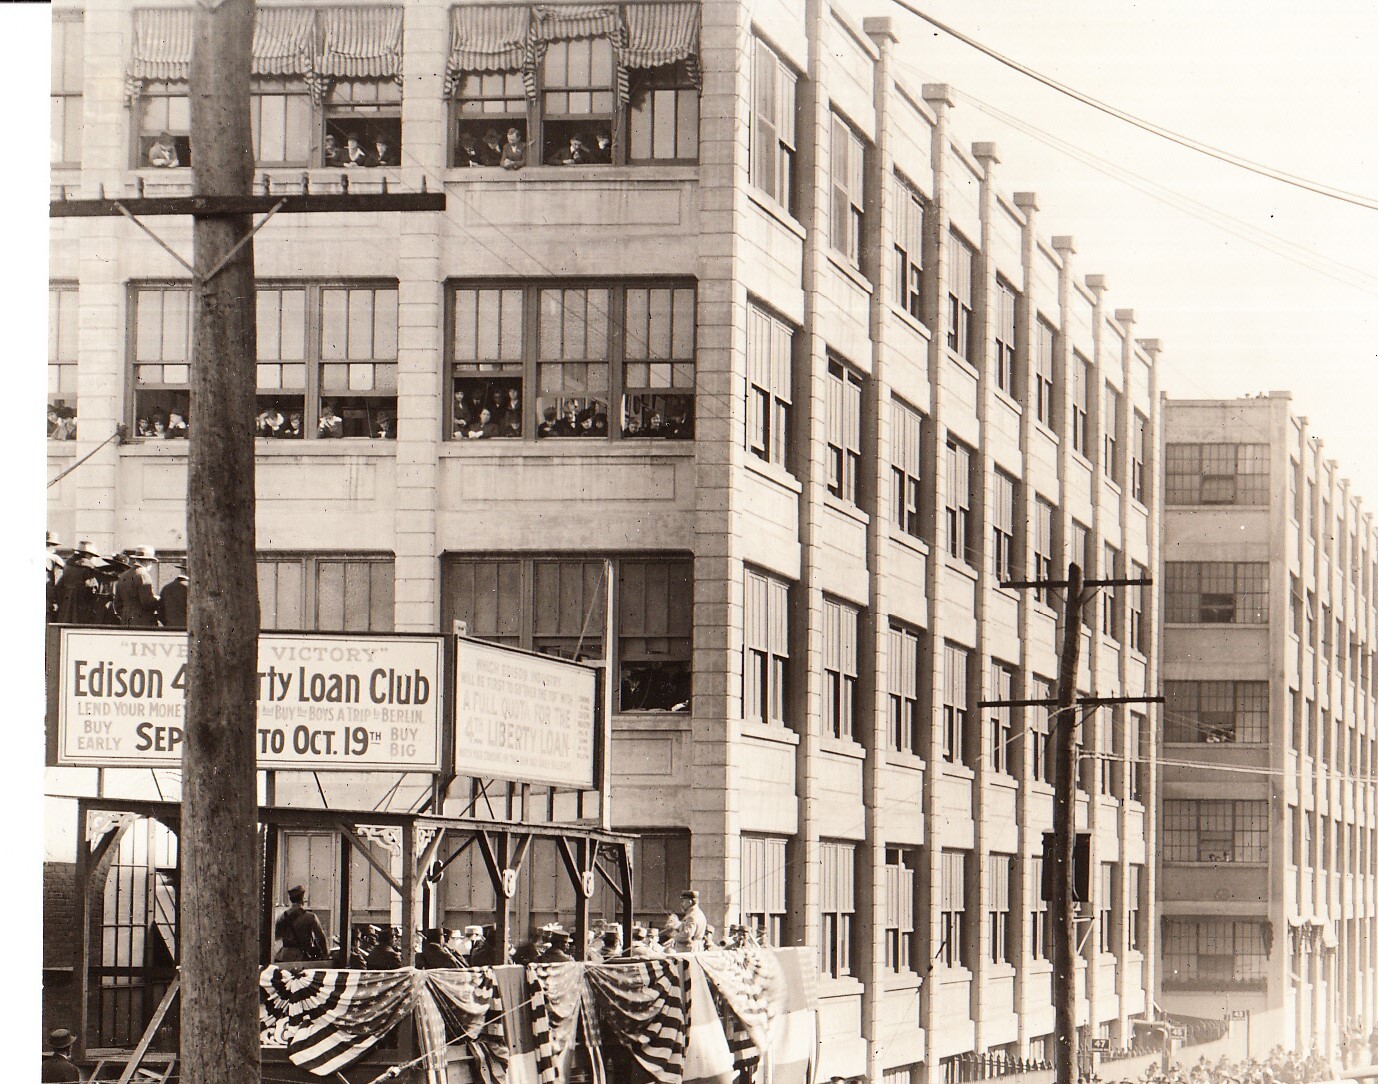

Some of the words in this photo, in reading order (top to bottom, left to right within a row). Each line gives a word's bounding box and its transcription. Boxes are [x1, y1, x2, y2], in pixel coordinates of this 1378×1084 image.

[121, 641, 188, 659] "INVE
[74, 660, 163, 698] Edison
[298, 666, 360, 703] Loan
[369, 668, 430, 705] Club
[78, 701, 111, 716] LEND
[113, 701, 145, 717] YOUR
[149, 702, 184, 718] MONE
[275, 705, 295, 720] BUY
[309, 705, 334, 721] BOYS
[337, 707, 345, 722] A
[346, 706, 371, 722] TRIP
[463, 689, 471, 711] A
[473, 691, 498, 715] FULL
[534, 703, 552, 724] FOR
[554, 707, 571, 729] THE
[84, 719, 112, 735] BUY
[390, 727, 419, 742] BUY
[78, 736, 122, 751] EARLY
[135, 722, 184, 752] SEP
[258, 728, 285, 754] TO
[293, 725, 338, 756] OCT.
[487, 719, 537, 751] LIBERTY
[540, 728, 570, 757] LOAN
[390, 743, 417, 757] BIG
